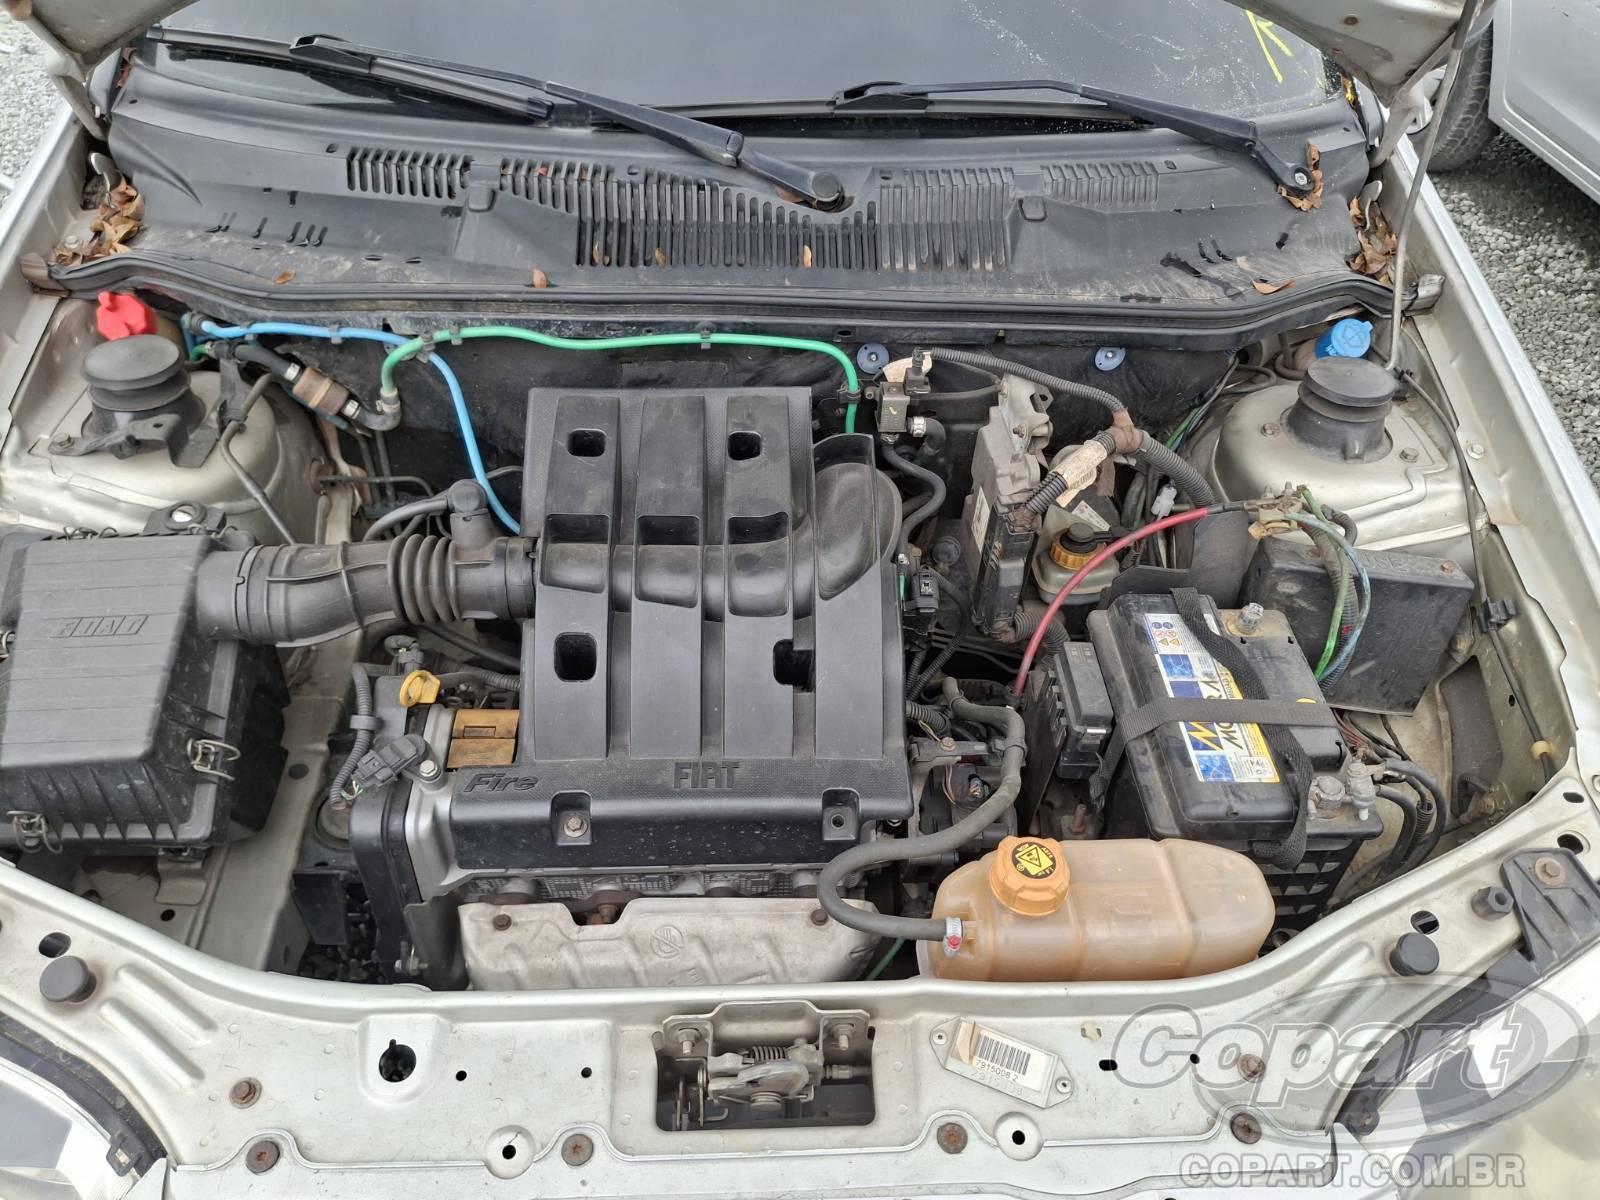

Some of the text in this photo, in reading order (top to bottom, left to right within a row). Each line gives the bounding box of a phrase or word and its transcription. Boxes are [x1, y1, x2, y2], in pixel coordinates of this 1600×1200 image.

[55, 616, 145, 637] FIAT
[464, 773, 540, 793] Fire
[672, 761, 740, 789] FIAT
